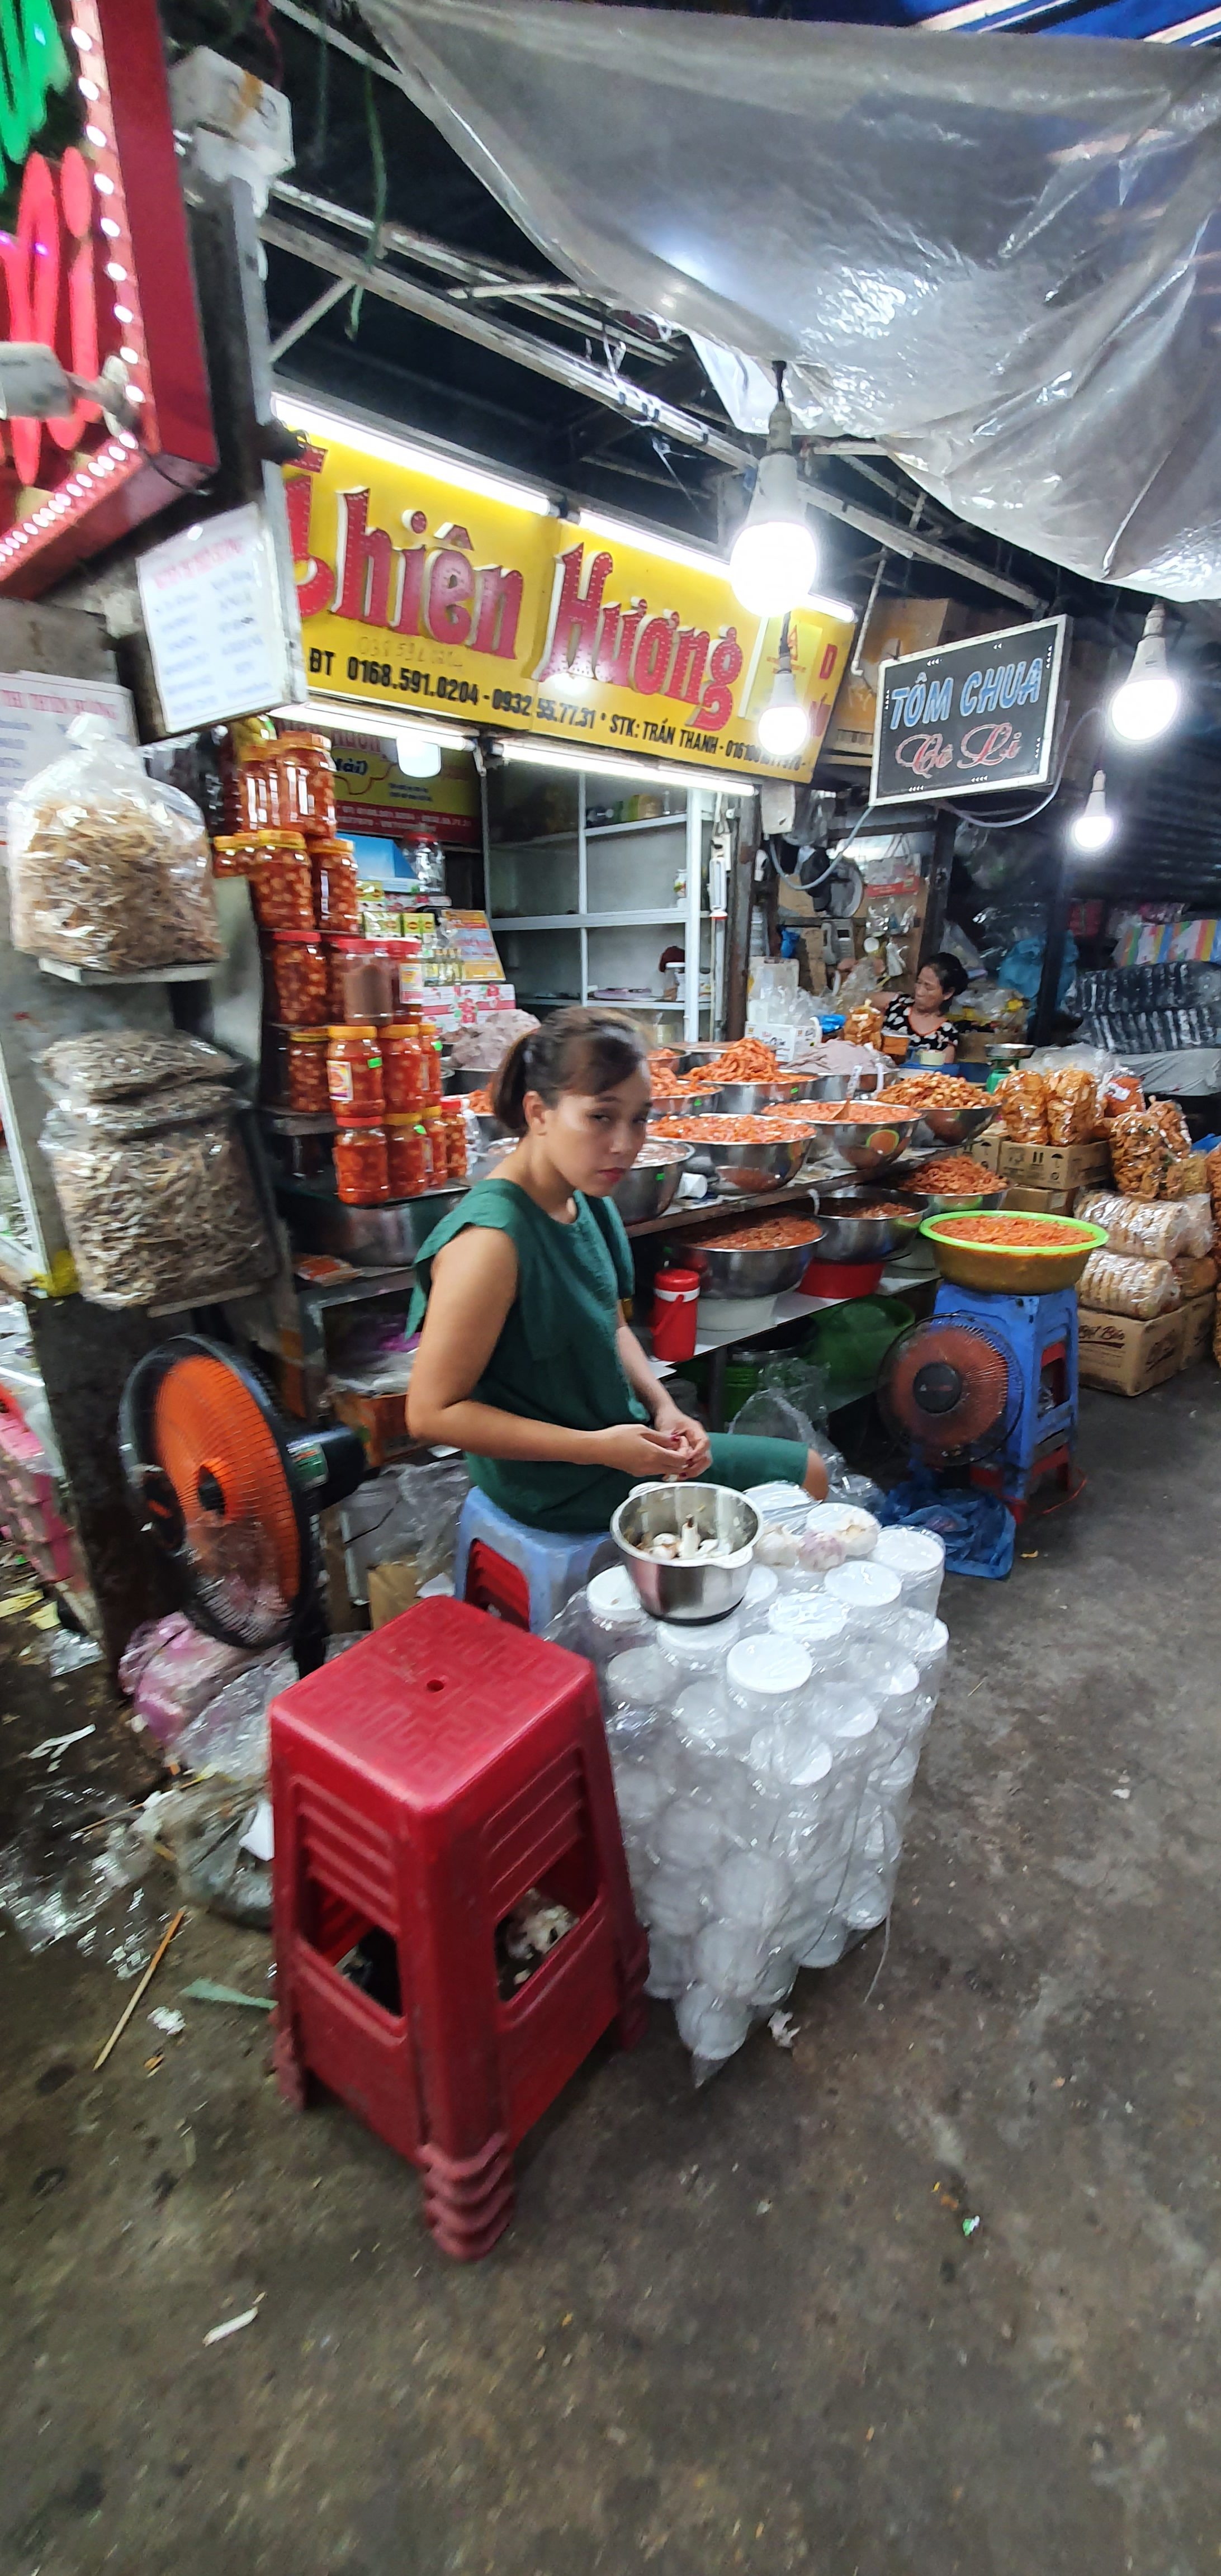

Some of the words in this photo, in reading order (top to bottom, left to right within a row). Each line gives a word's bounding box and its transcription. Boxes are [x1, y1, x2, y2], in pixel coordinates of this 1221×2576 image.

[534, 542, 744, 732] Hương
[348, 656, 479, 705] 0168.591.0204
[609, 714, 640, 738] STK:
[679, 728, 720, 755] THANH
[889, 671, 954, 730] TÔM
[959, 657, 1043, 717] CHUA
